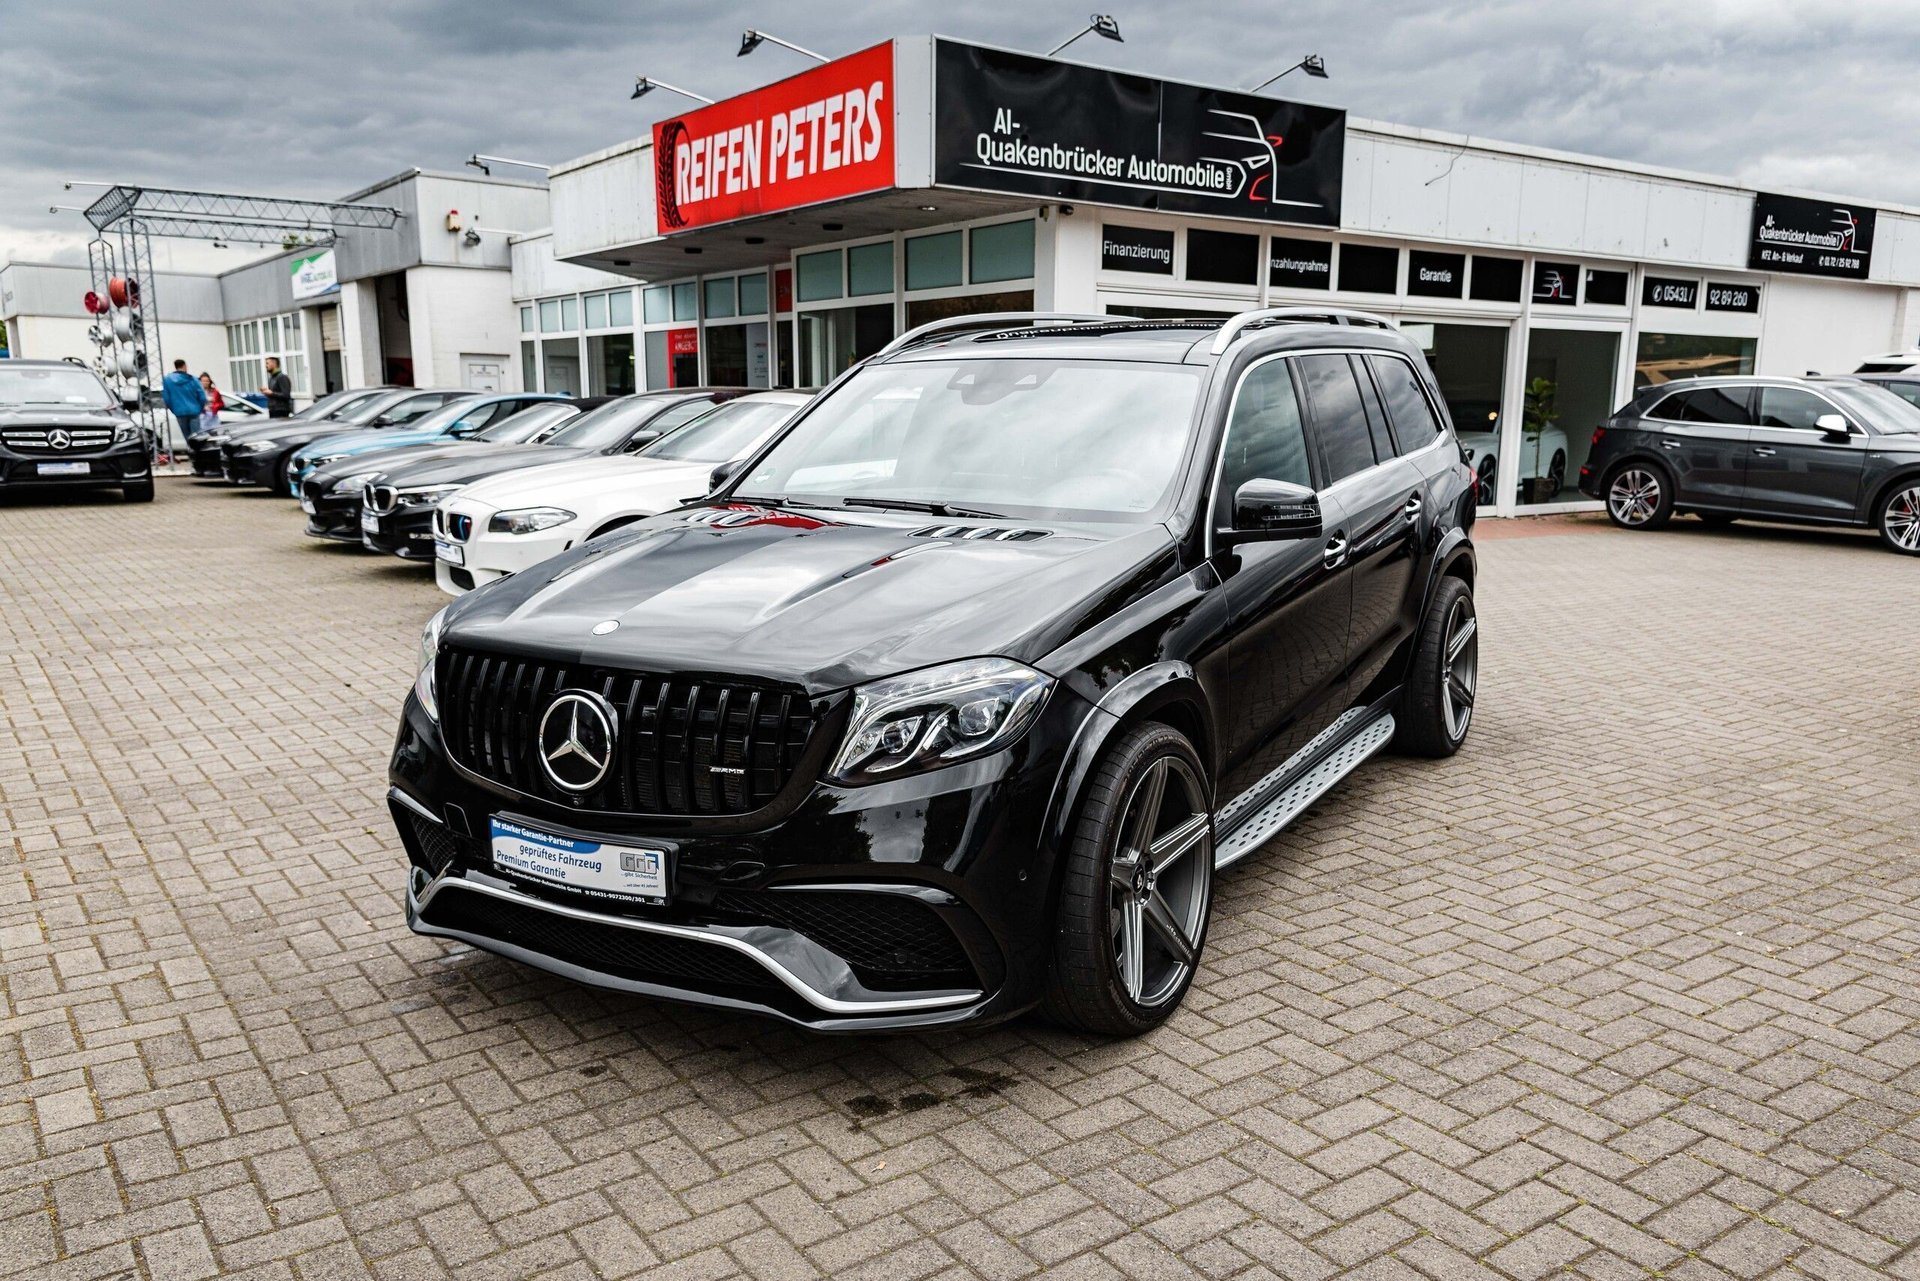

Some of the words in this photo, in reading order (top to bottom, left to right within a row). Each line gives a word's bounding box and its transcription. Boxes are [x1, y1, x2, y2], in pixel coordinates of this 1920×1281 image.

[676, 119, 764, 206] REIFEN
[768, 80, 883, 185] PETERS
[976, 132, 1126, 178] Quakenbrücker
[1127, 154, 1225, 190] Automobile
[1225, 166, 1233, 191] GmbH
[1759, 225, 1805, 242] Quakenbrücker
[1804, 231, 1837, 246] Automobile
[1103, 240, 1171, 265] Finanzierung
[1270, 257, 1329, 273] nzahlungnahme
[1419, 267, 1452, 283] Garantie
[491, 819, 501, 829] Ihr
[501, 822, 521, 835] starker
[521, 828, 575, 848] Garantie-Partner
[496, 849, 529, 869] Premium
[530, 860, 566, 879] Garantie
[519, 844, 557, 862] geprüftes
[558, 852, 602, 872] Fahrzeug
